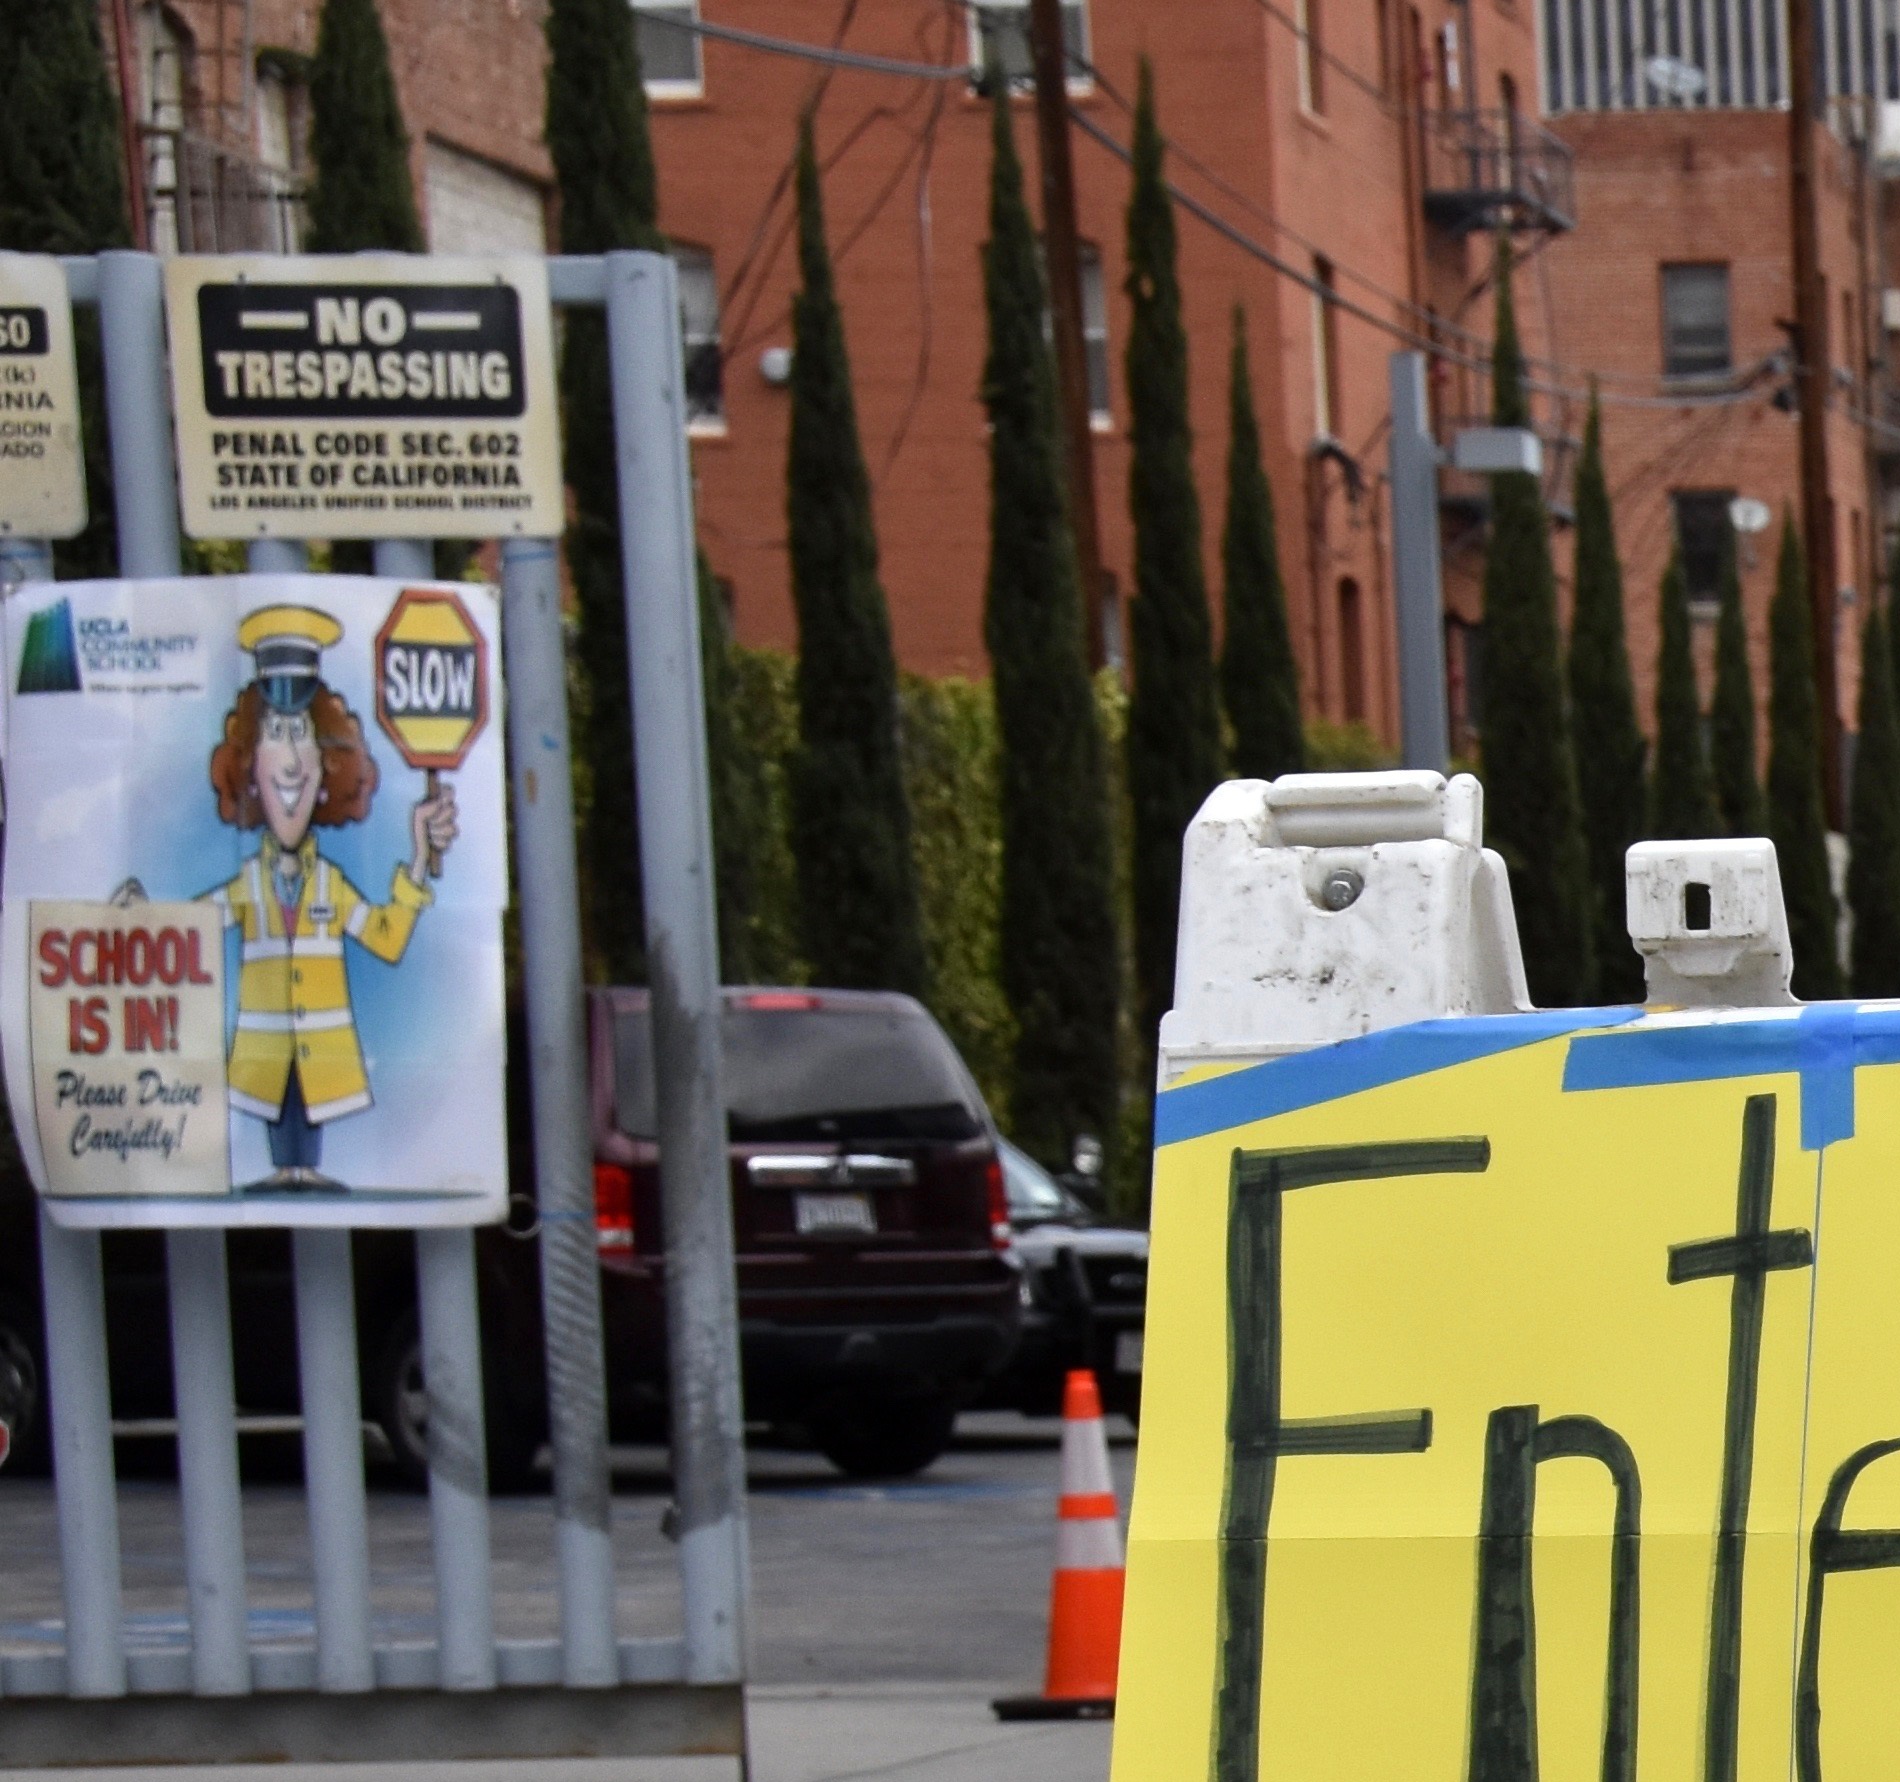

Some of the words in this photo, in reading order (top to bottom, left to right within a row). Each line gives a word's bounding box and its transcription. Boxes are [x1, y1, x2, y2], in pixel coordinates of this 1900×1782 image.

[315, 297, 407, 347] NO
[215, 350, 512, 399] TRESPASSING
[213, 432, 305, 458] PENAL
[315, 433, 389, 458] CODE
[402, 432, 462, 458] SEC.
[469, 433, 521, 457] 602
[218, 462, 298, 488] STATE
[310, 463, 345, 487] OF
[353, 462, 520, 488] CALIFORNIA
[384, 646, 475, 712] SLOW
[38, 926, 214, 988] SCHOOL
[69, 995, 111, 1056] IS
[123, 996, 180, 1053] IN!
[56, 1067, 128, 1110] Please
[137, 1067, 202, 1106] Drive
[69, 1113, 188, 1162] Carefully!
